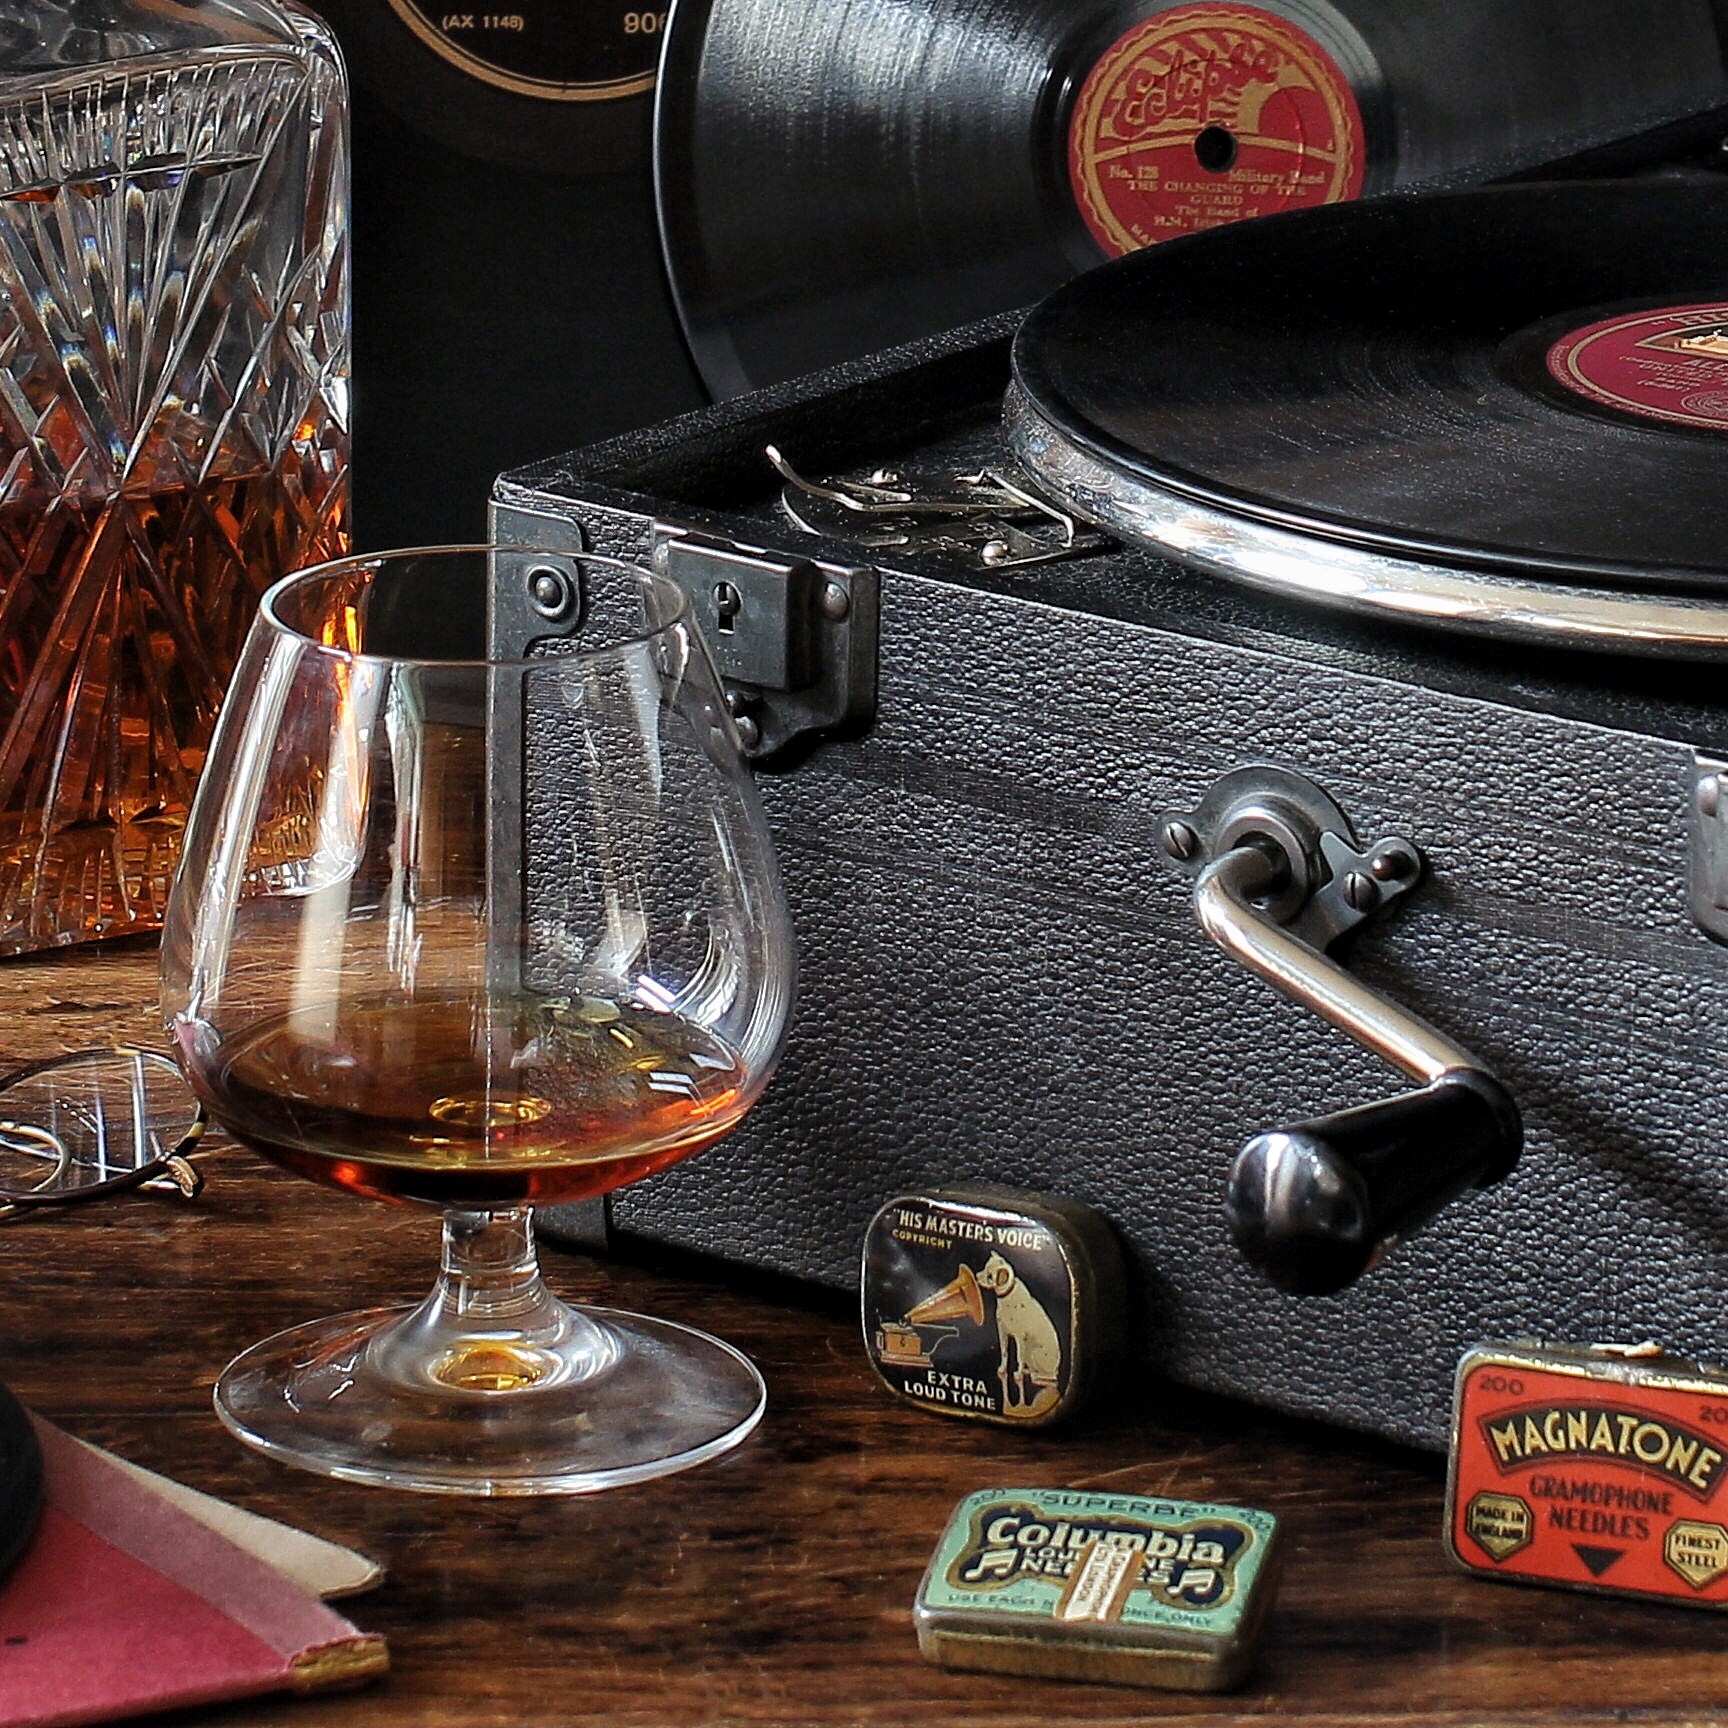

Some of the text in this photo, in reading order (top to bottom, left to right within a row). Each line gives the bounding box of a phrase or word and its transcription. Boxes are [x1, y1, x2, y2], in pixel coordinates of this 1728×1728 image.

[1127, 180, 1159, 192] THE
[1164, 180, 1244, 194] CHANGING
[1250, 183, 1271, 196] OF
[1190, 194, 1244, 206] GUARD
[892, 1207, 923, 1229] "HIS
[925, 1214, 994, 1243] MASTER'S
[891, 1227, 953, 1250] COPYRIGHT
[927, 1369, 988, 1395] EXTRA
[1477, 1373, 1526, 1396] 200
[903, 1379, 997, 1411] LOUD TONE
[1488, 1409, 1723, 1489] MAGNATONE
[1528, 1473, 1675, 1518] GRAMOPHONE
[1475, 1505, 1527, 1523] MADE IN
[1548, 1505, 1651, 1542] NEEDLES
[986, 1516, 1225, 1566] Columbia
[1674, 1535, 1722, 1552] FINEST
[1023, 1545, 1081, 1562] LOU
[1677, 1551, 1719, 1570] STEEL
